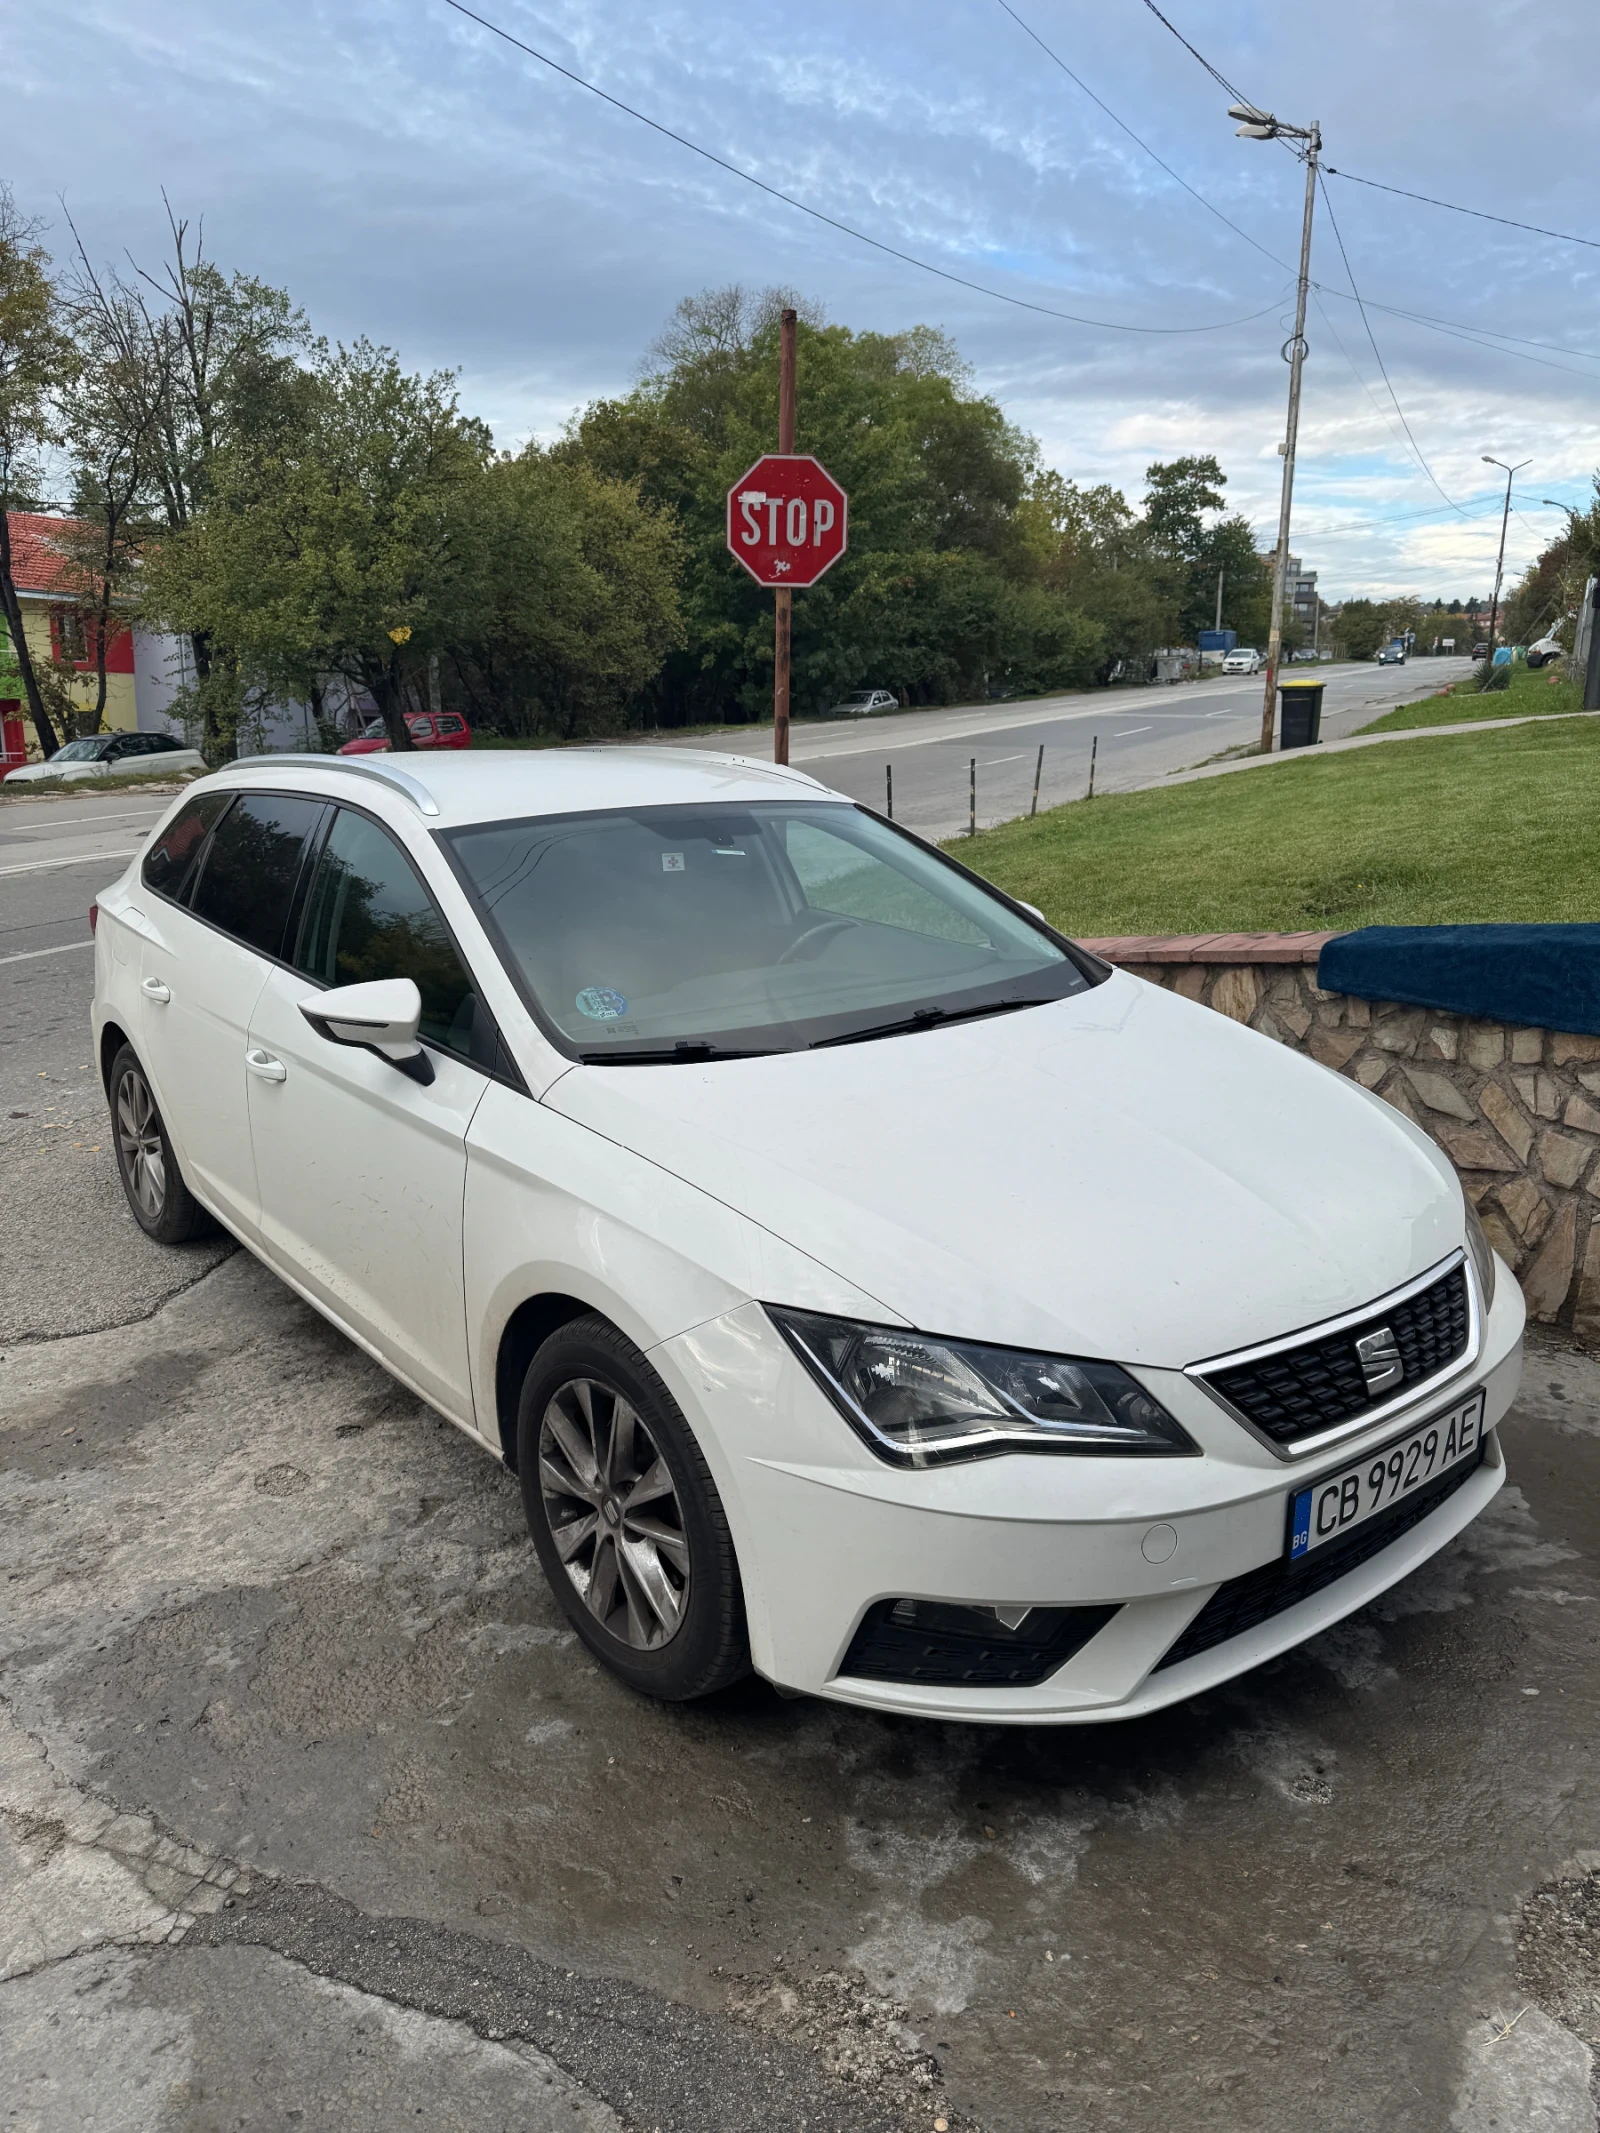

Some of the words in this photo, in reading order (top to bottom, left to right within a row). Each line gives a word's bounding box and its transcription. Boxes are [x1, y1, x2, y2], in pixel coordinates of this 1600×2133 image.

[741, 497, 835, 547] STOP
[1316, 1474, 1360, 1536] CB
[1368, 1429, 1439, 1510] 9929
[1441, 1402, 1477, 1467] AE
[1292, 1530, 1309, 1550] BG
